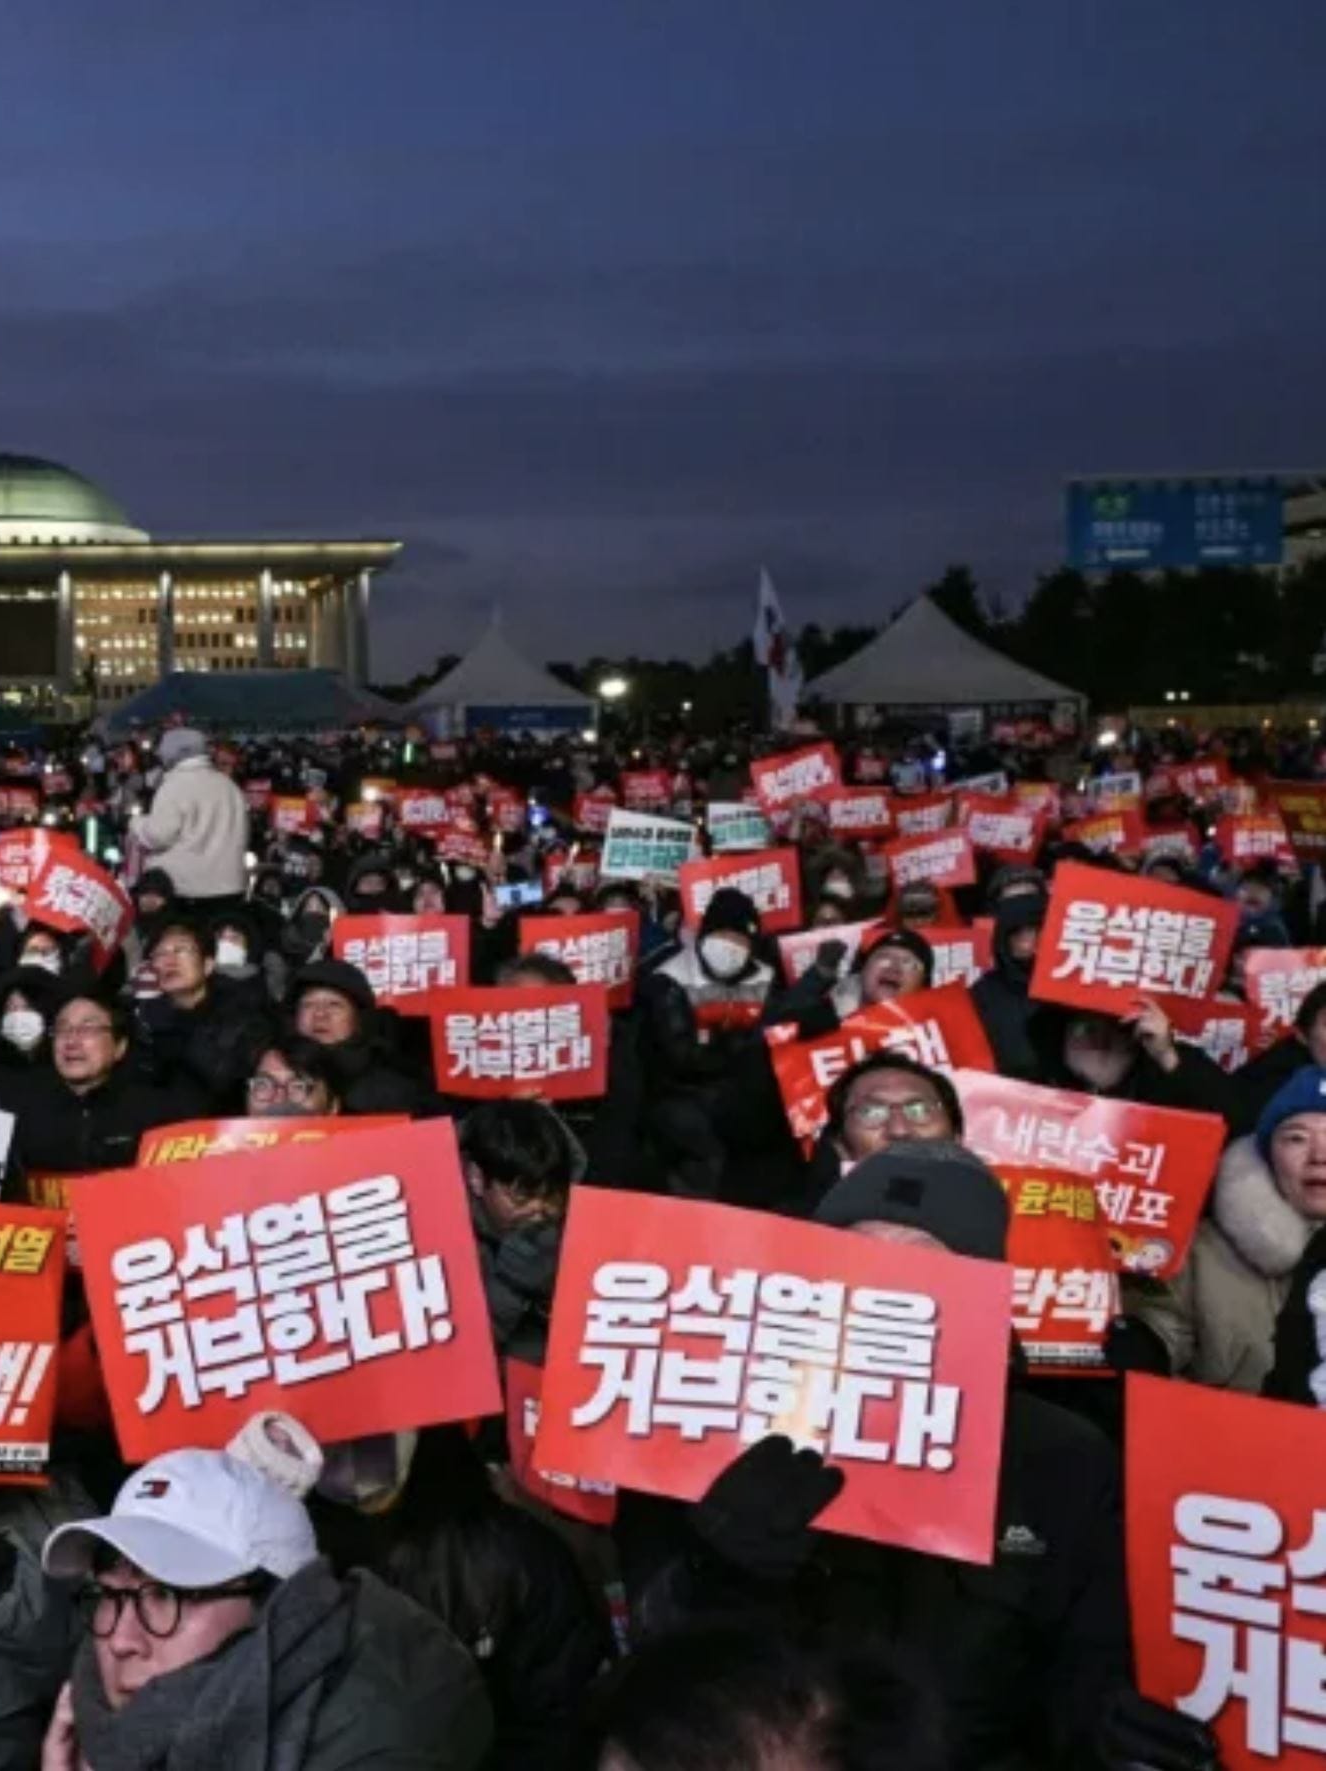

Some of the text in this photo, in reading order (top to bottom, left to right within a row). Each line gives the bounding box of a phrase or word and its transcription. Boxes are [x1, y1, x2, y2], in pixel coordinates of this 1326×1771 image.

[1062, 901, 1215, 961] 윤석열을
[445, 1002, 581, 1051] 윤석열을
[447, 1034, 592, 1080] 거부한다!
[992, 1107, 1165, 1185] 내란수괴
[1094, 1179, 1175, 1229] 체포
[111, 1174, 415, 1334] 윤석열을
[124, 1255, 455, 1414] 거부한다!
[584, 1262, 938, 1380] 윤석열을
[570, 1347, 960, 1474] 거부한다!
[1170, 1492, 1326, 1634] 윤
[1170, 1608, 1326, 1758] 거
